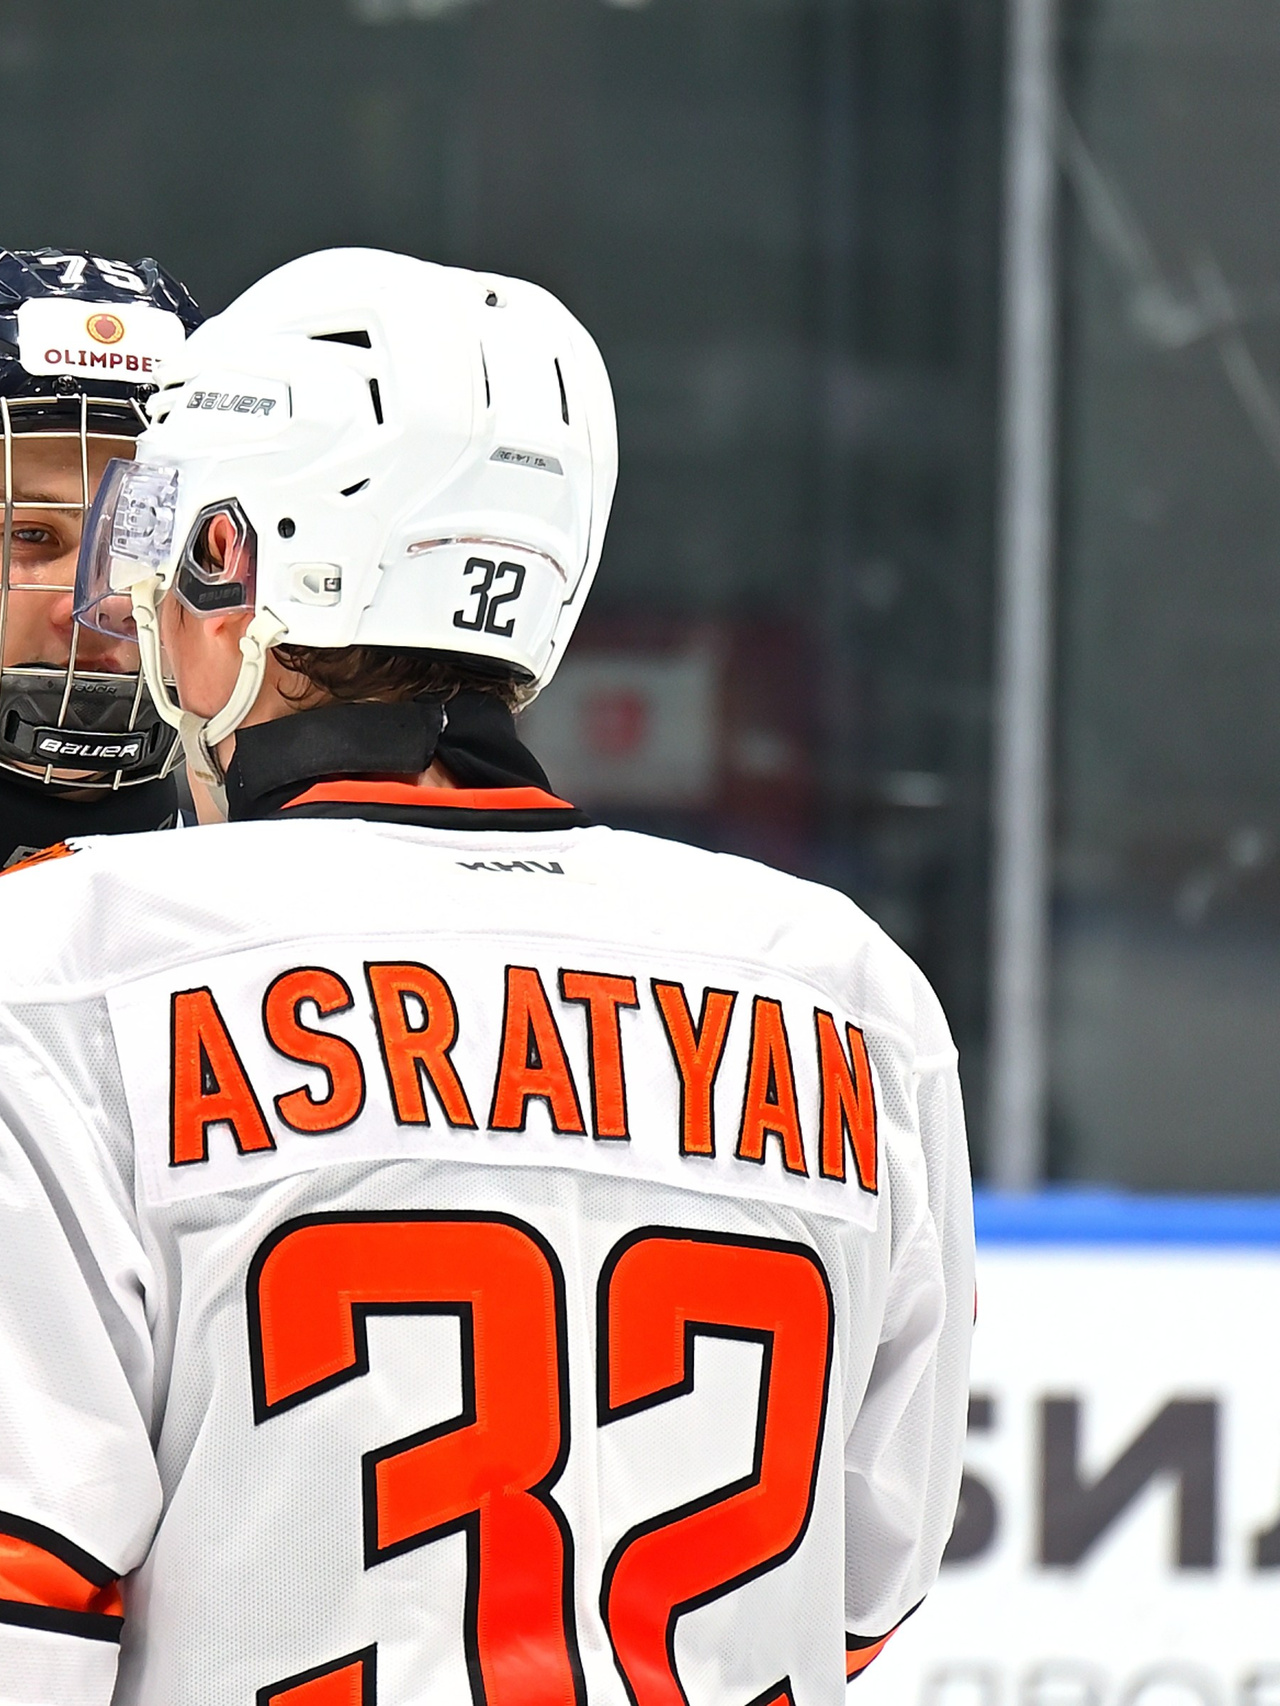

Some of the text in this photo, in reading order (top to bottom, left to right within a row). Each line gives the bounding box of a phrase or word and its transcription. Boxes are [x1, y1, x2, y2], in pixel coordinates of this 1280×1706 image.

[37, 254, 151, 294] 75
[44, 348, 162, 373] OLIMPBE
[453, 557, 526, 638] 32
[39, 738, 139, 758] BAUER
[169, 961, 878, 1195] ASRATYAN
[246, 1209, 834, 1706] 32
